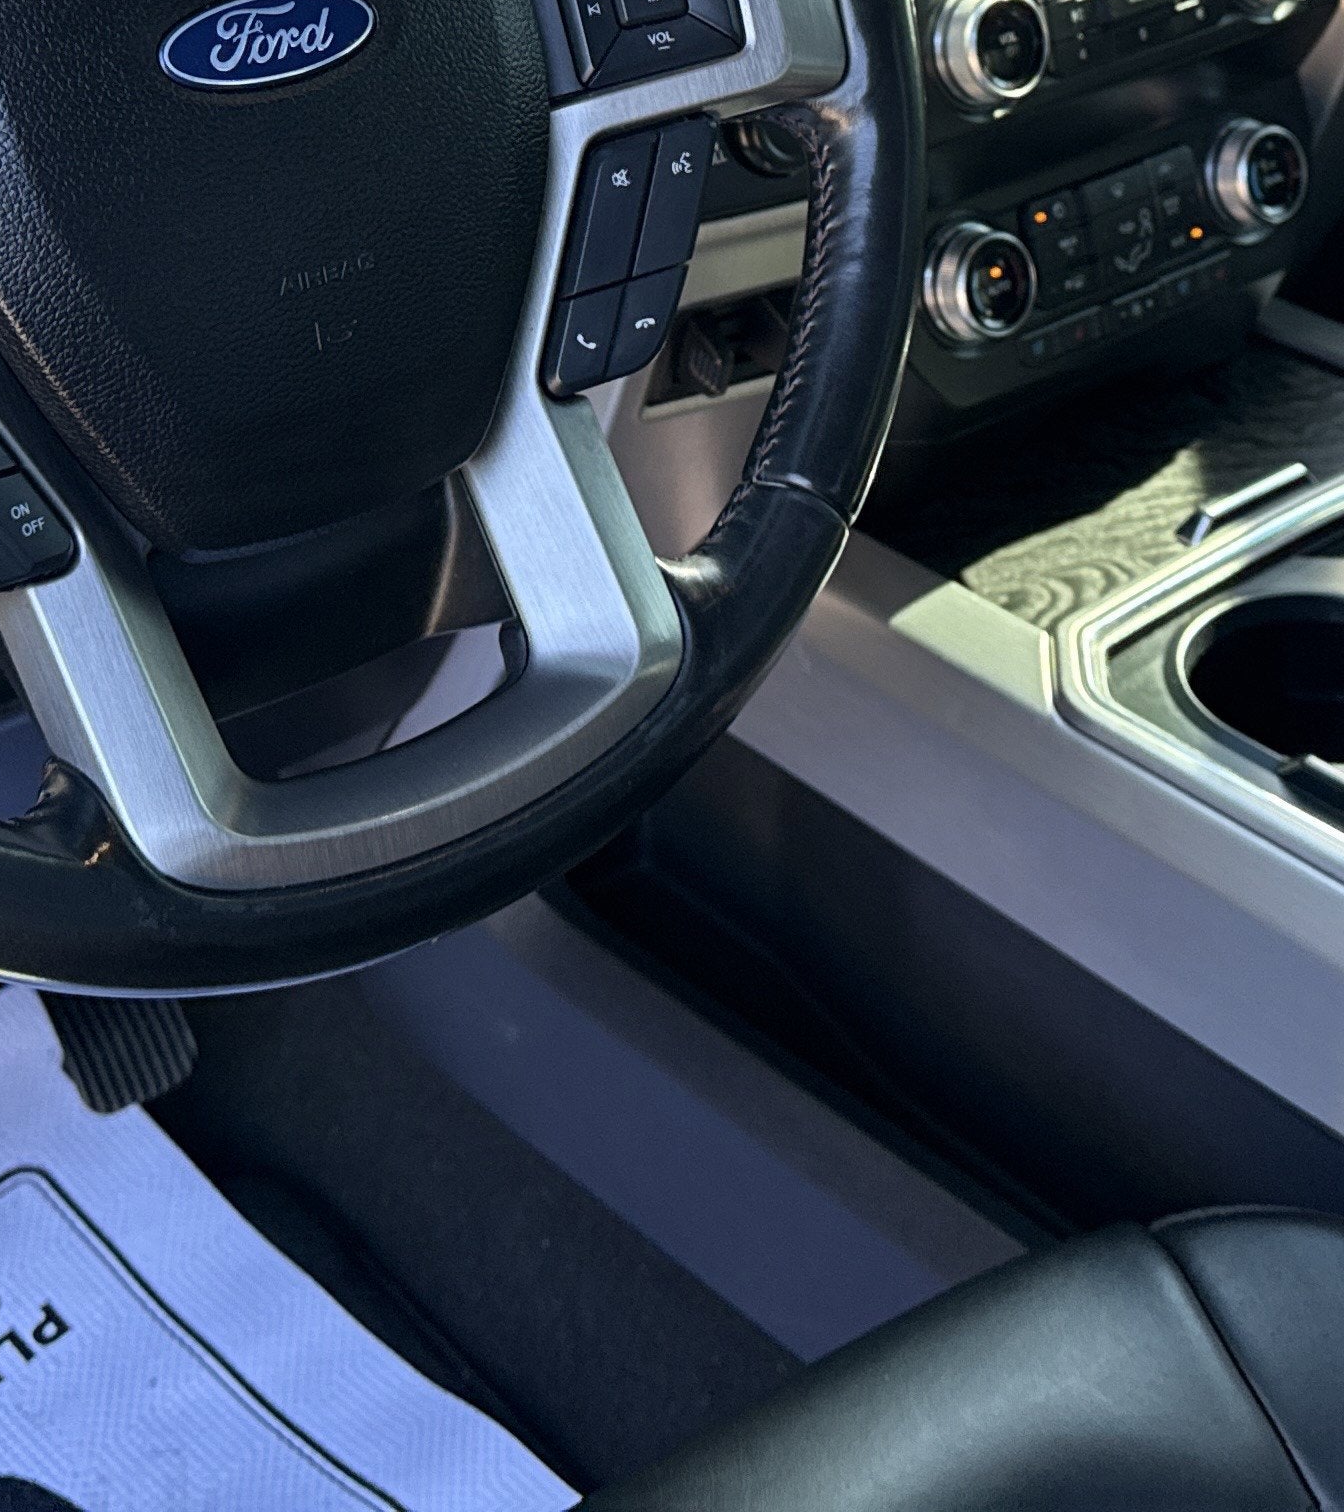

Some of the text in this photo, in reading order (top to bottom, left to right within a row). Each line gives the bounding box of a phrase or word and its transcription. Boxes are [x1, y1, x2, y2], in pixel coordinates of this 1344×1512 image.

[210, 0, 334, 72] Ford
[647, 31, 676, 46] VOL
[10, 502, 31, 520] ON
[21, 516, 46, 538] OFF
